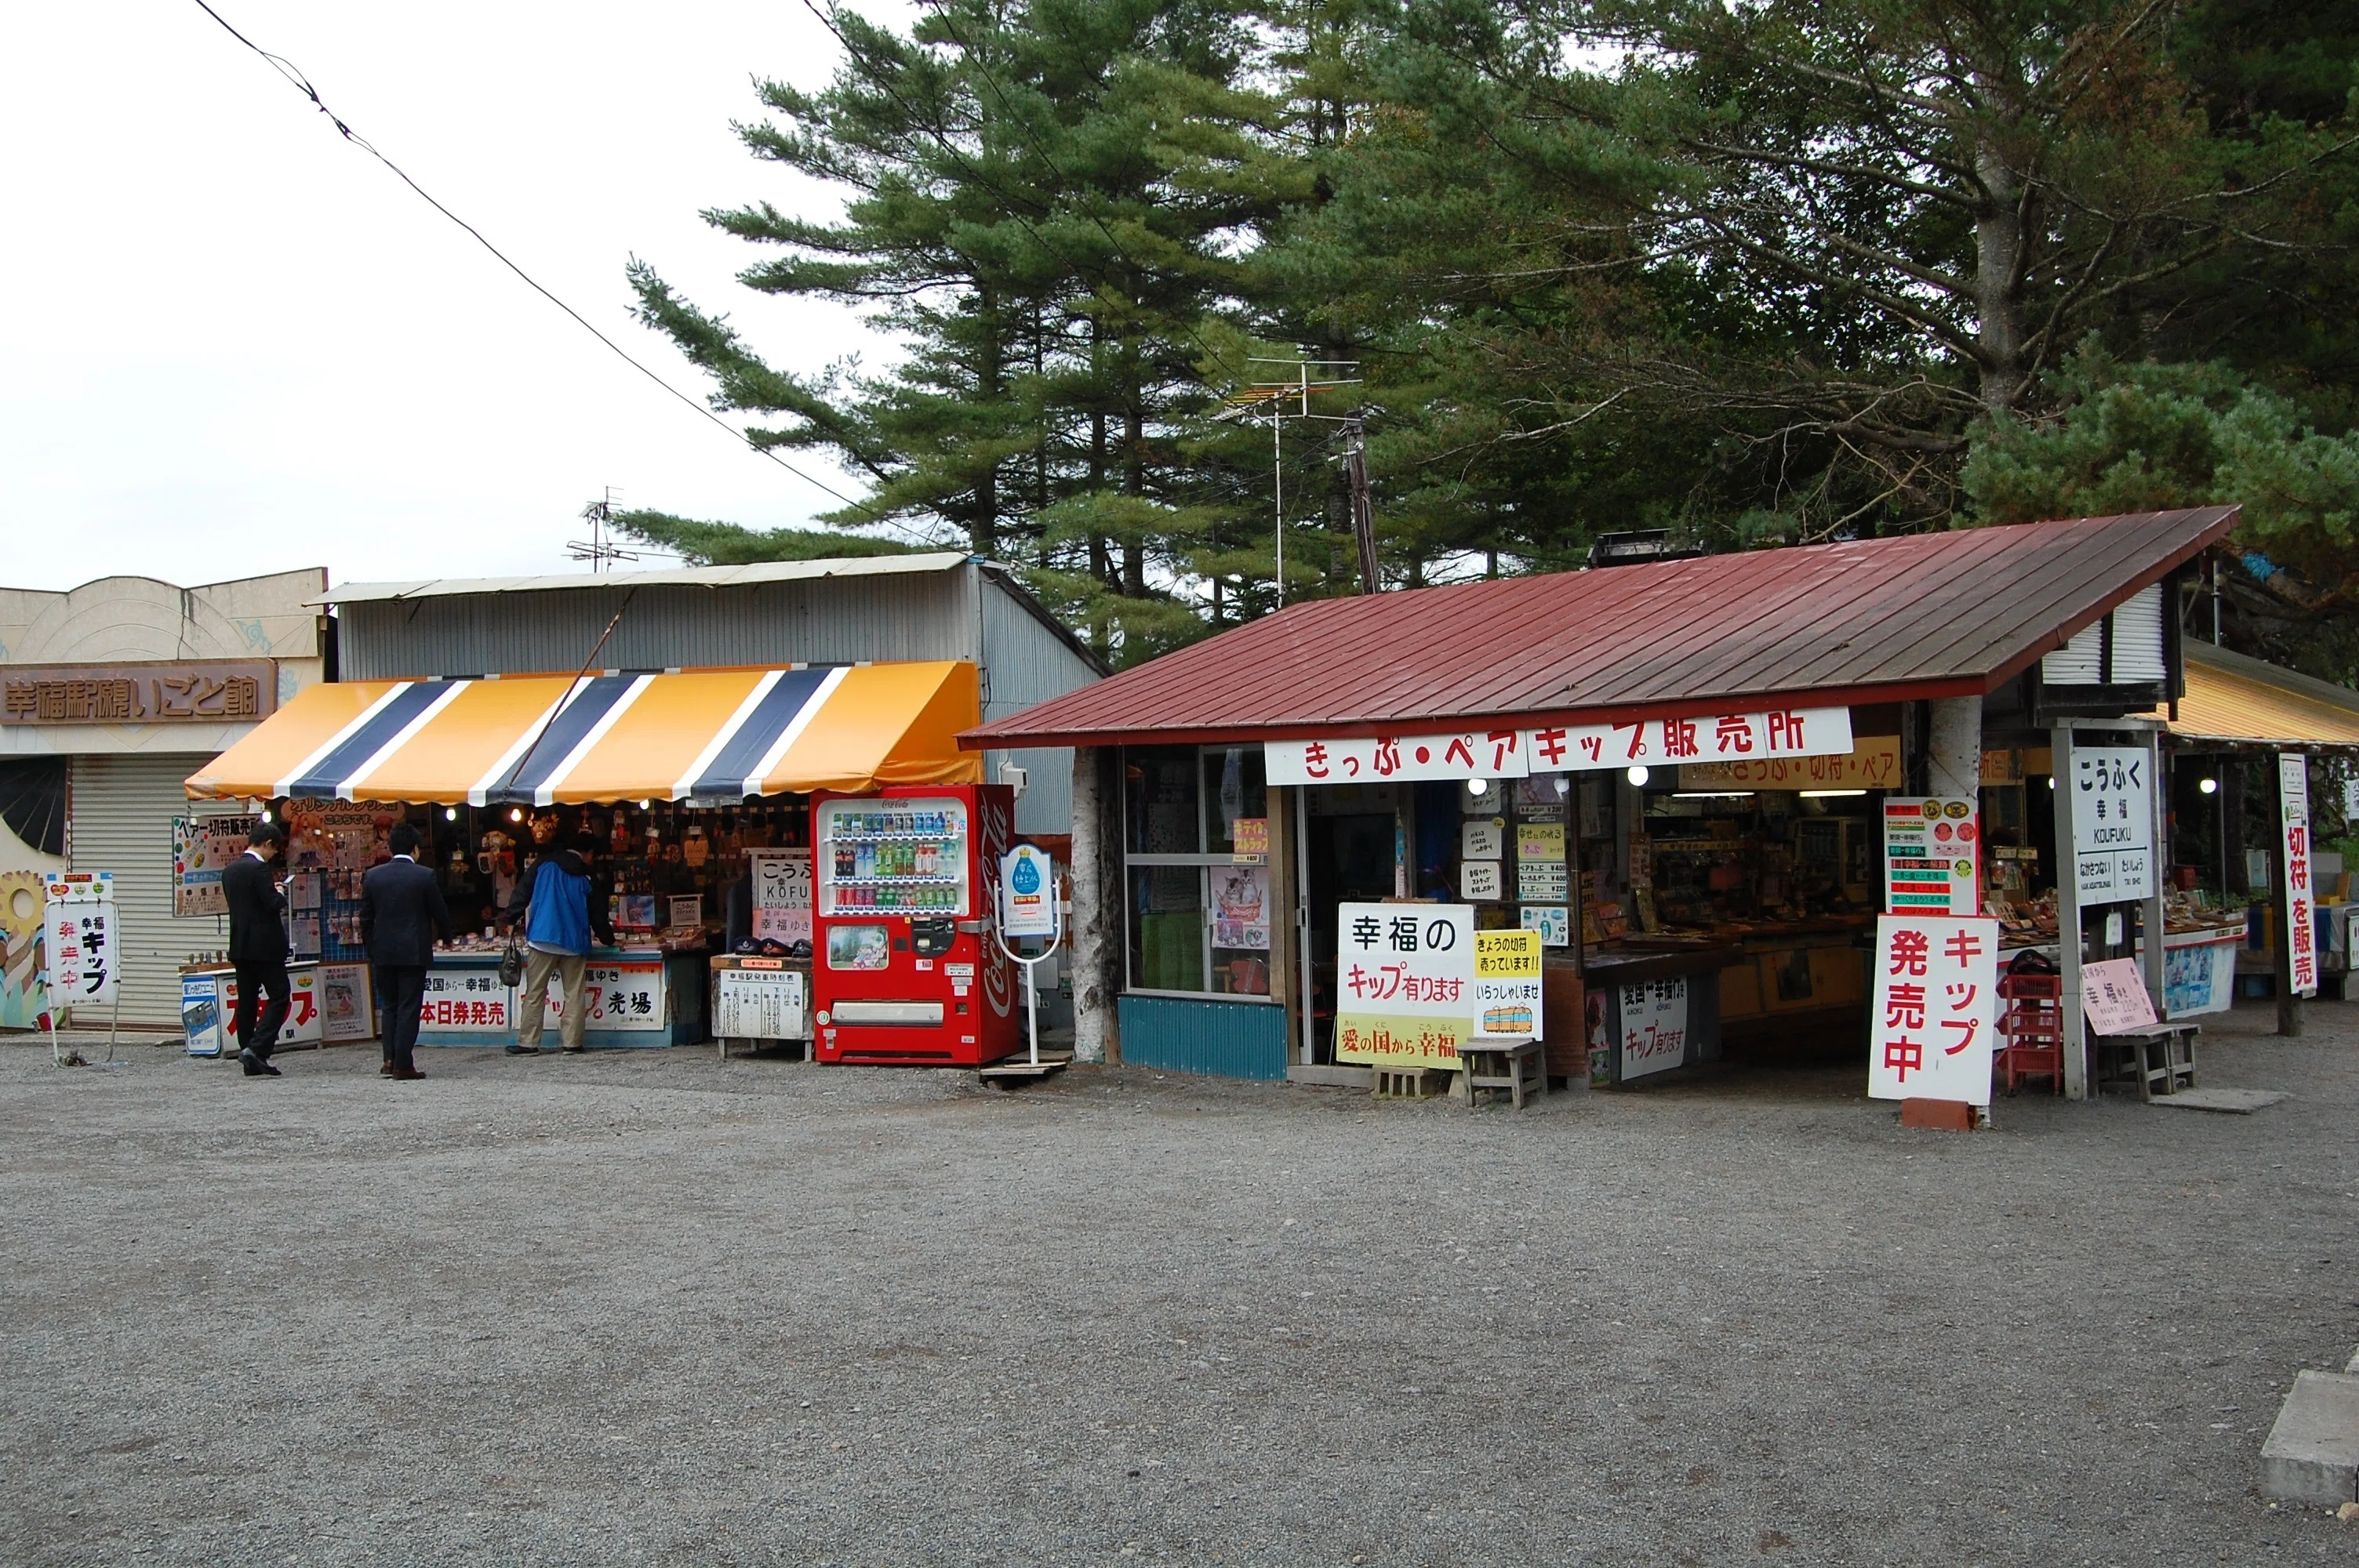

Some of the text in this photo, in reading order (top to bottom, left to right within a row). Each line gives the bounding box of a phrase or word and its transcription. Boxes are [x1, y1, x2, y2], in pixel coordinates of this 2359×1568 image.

[5, 673, 259, 719] 幸福駅願いごと館
[2081, 758, 2141, 792] こうふく
[2097, 799, 2127, 820] 幸福
[2094, 828, 2131, 844] KOUFUKU
[82, 916, 104, 931] 幸福
[1352, 915, 1456, 952] 幸福の
[59, 921, 78, 990] 発売中
[1478, 937, 1528, 953] きょうの切符
[82, 931, 107, 995] キップ
[1347, 960, 1465, 1003] キップ有ります
[1476, 985, 1539, 1000] いらっしゃいませ
[1940, 929, 1983, 1056] キップ
[420, 1000, 504, 1025] 本日券発売
[608, 991, 652, 1014] 売場
[1884, 930, 1929, 1083] 発売中
